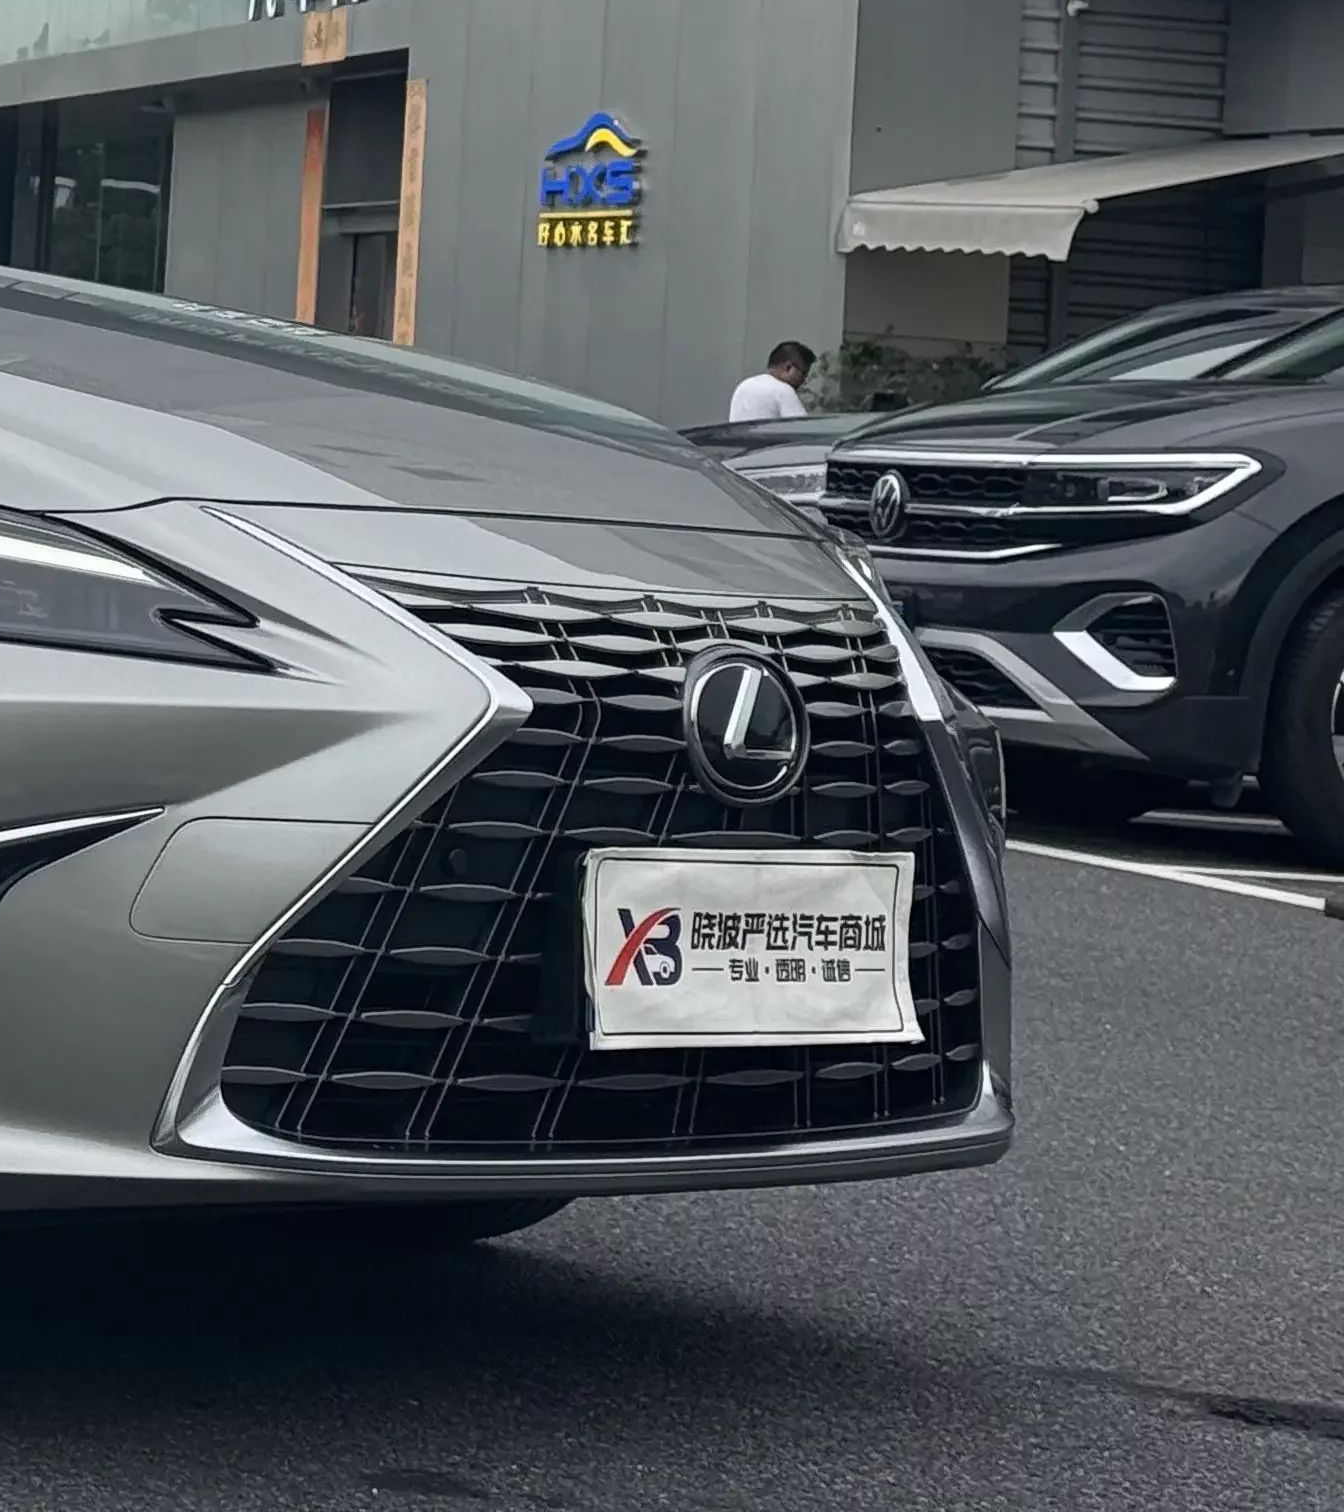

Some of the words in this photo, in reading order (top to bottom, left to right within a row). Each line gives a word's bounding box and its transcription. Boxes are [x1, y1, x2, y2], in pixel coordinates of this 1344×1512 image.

[539, 159, 634, 207] HXS
[690, 911, 887, 952] 晓波严选汽车商城
